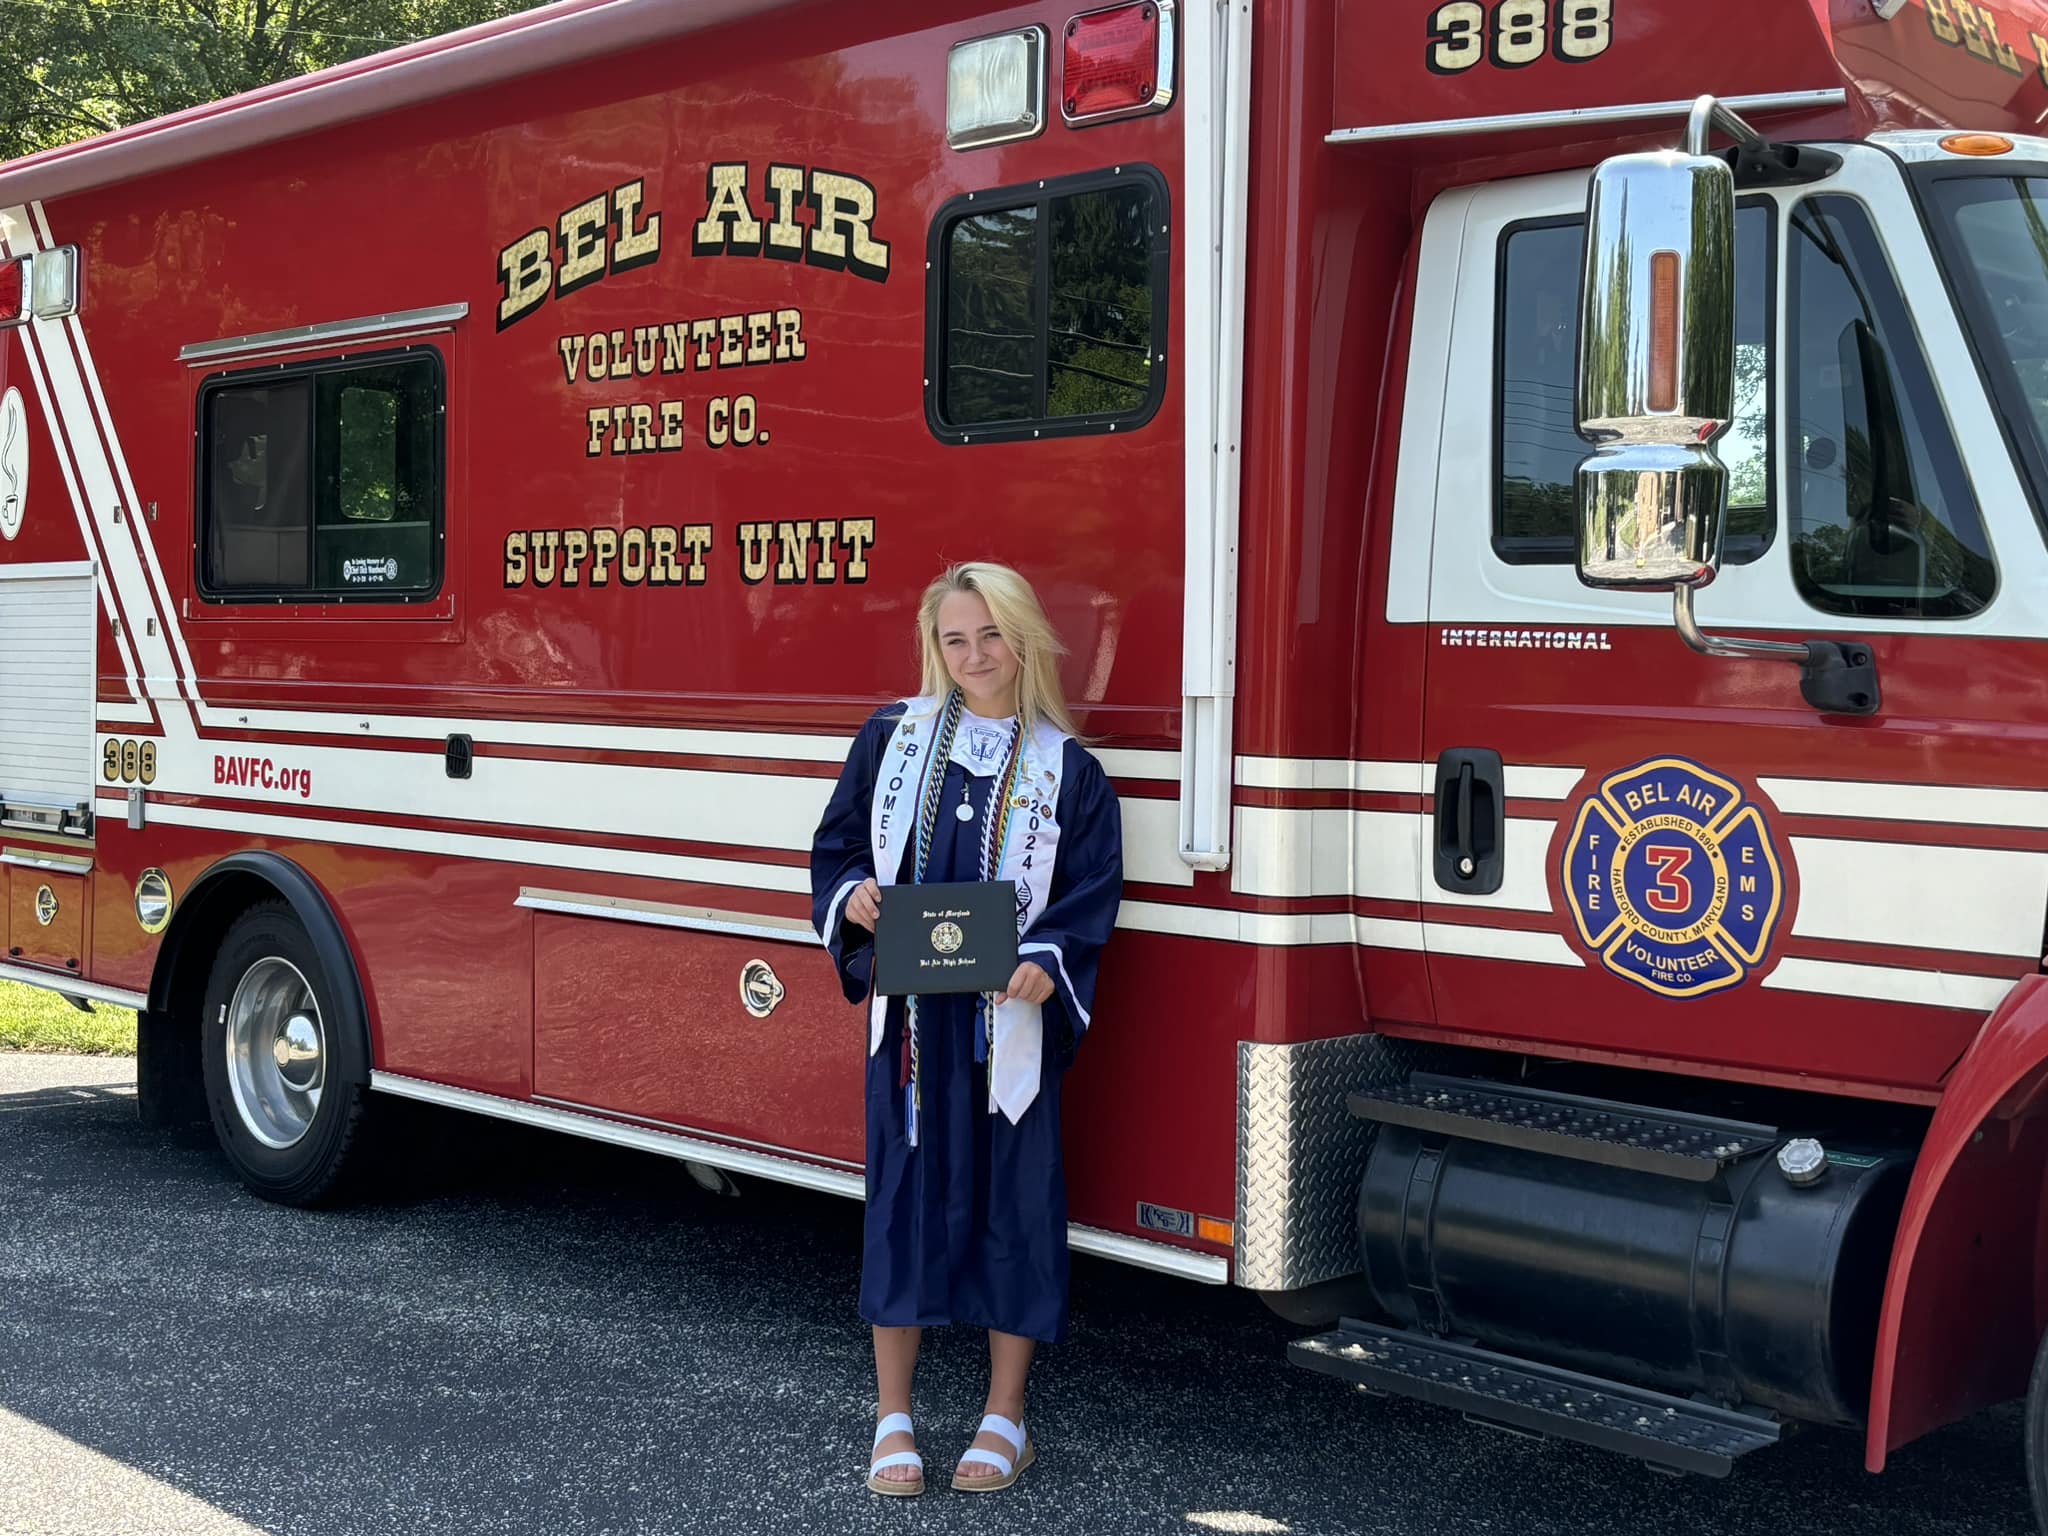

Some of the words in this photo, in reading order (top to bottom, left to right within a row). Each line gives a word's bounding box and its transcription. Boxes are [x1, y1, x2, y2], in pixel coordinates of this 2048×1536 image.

[1426, 0, 1612, 75] 388
[1926, 0, 2024, 78] BEL
[497, 177, 661, 333] BEL
[692, 161, 890, 283] AIR
[559, 309, 806, 384] VOLUNTEER
[586, 401, 683, 457] FIRE
[706, 395, 770, 447] CO.
[504, 524, 712, 588] SUPPORT
[737, 517, 875, 584] UNIT
[1442, 629, 1611, 650] INTERNATIONAL
[103, 738, 157, 785] 388
[214, 755, 311, 798] BAVFC.org
[879, 743, 918, 849] BIOMED
[1625, 782, 1670, 811] BEL
[1676, 784, 1716, 816] AIR
[1022, 800, 1040, 870] 2024
[1623, 816, 1693, 846] ESTABLISHED
[1695, 828, 1716, 851] 1890
[1588, 835, 1600, 910] FIRE
[1612, 868, 1640, 925] HARFORD
[1692, 876, 1726, 936] MARYLAND
[1646, 845, 1692, 913] 3
[1740, 847, 1756, 922] EMS
[1627, 939, 1719, 971] VOLUNTEER
[1651, 969, 1674, 982] FIRE
